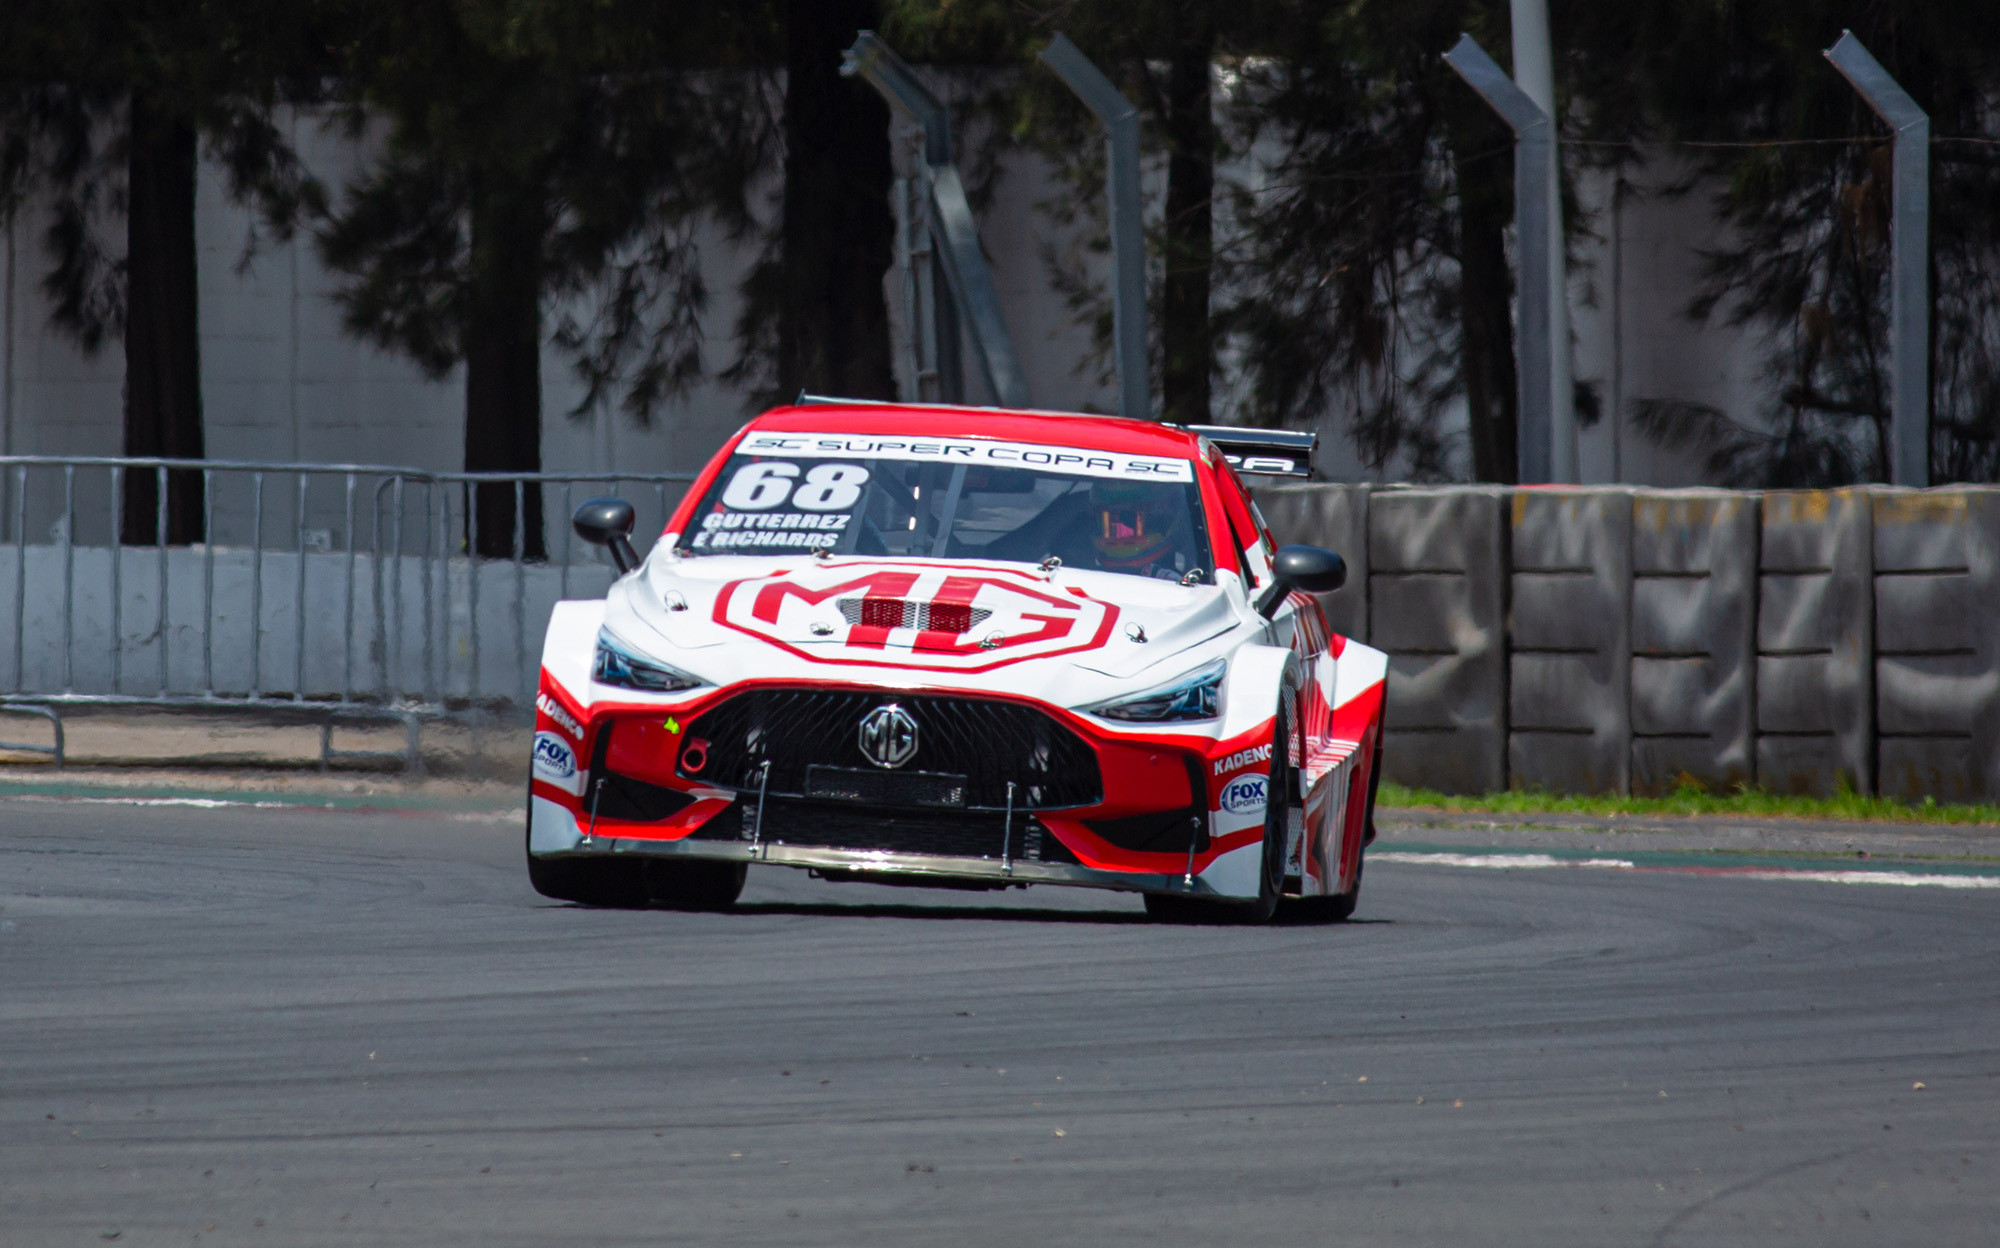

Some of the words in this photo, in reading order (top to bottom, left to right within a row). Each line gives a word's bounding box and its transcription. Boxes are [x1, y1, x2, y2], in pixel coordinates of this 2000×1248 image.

[748, 439, 810, 449] SC
[987, 448, 1114, 471] COPA
[1124, 460, 1183, 476] SC
[722, 461, 870, 511] 68
[702, 512, 852, 530] GUTIERREZ
[711, 531, 839, 548] RICHARDS
[751, 571, 1082, 657] MG
[864, 711, 914, 763] MG
[536, 738, 571, 768] FOX
[1230, 781, 1265, 802] FOX
[1231, 797, 1266, 809] SPORTS
